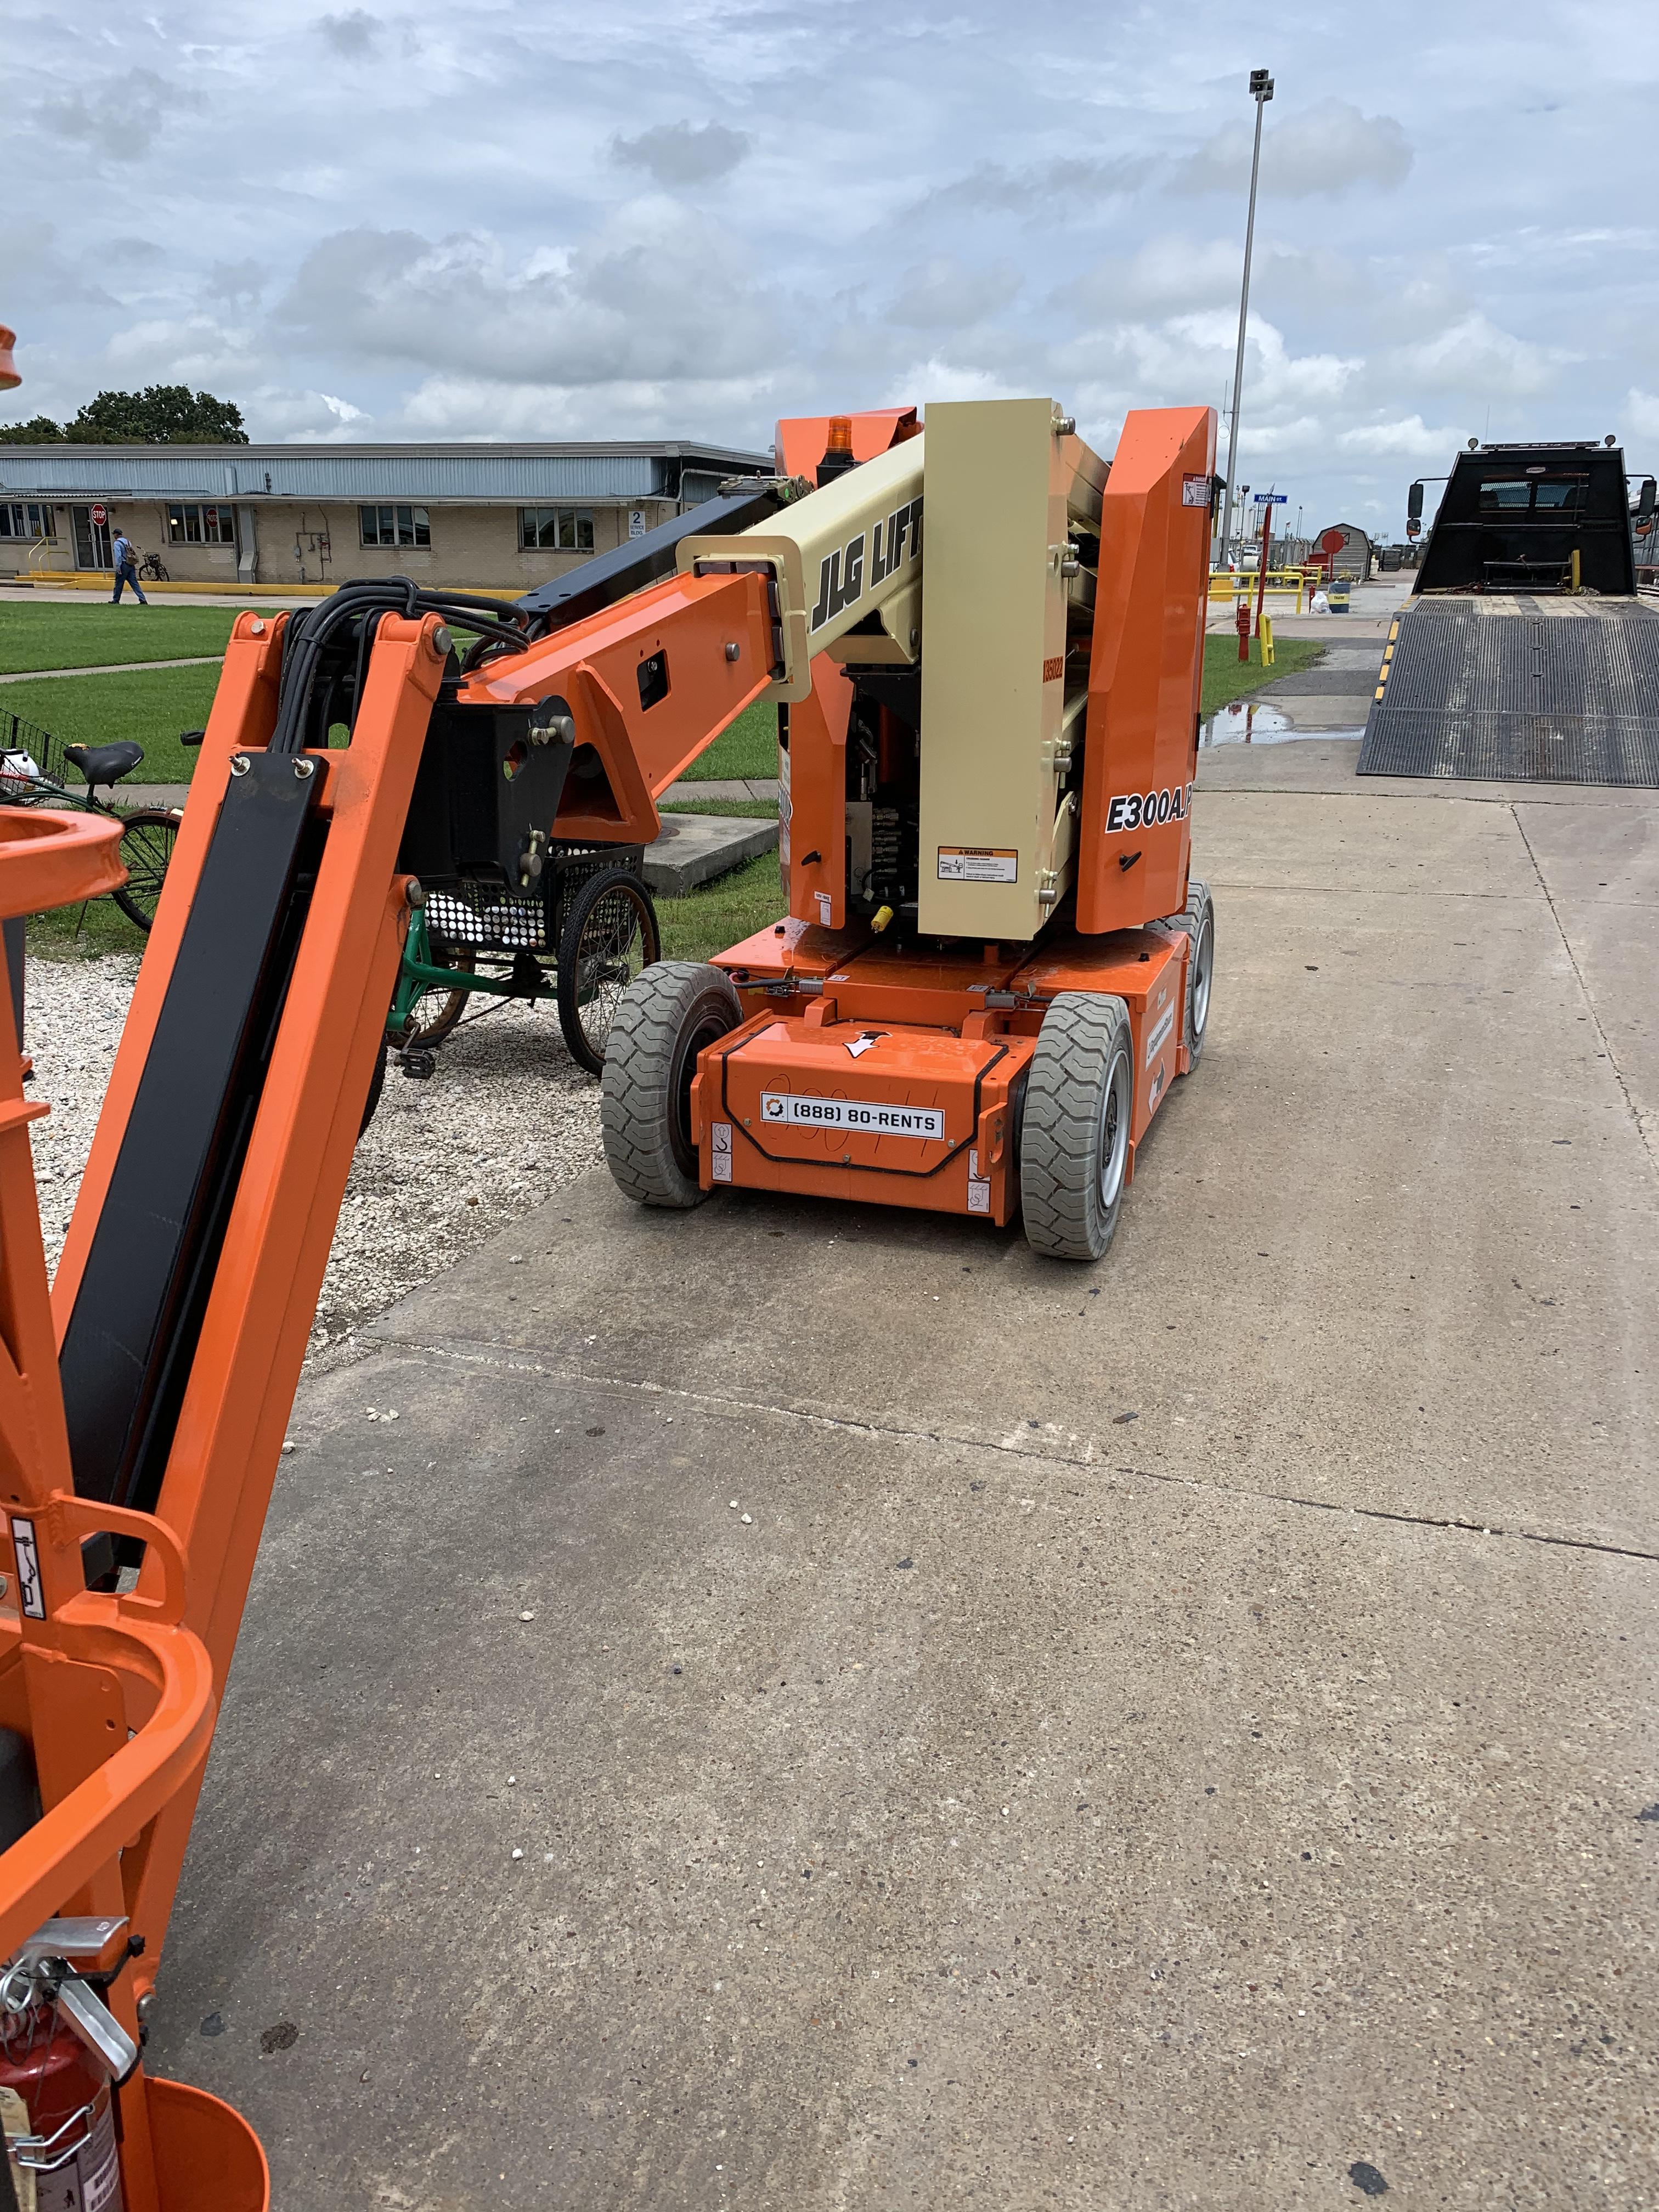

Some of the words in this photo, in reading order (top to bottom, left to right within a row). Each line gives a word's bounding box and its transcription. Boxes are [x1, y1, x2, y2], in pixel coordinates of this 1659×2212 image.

[93, 510, 105, 519] STOP
[633, 512, 641, 524] 2
[810, 531, 866, 636] JLG
[870, 493, 923, 591] LIFT
[1105, 782, 1193, 834] E300AJP
[794, 1103, 840, 1121] (888)
[848, 1109, 935, 1131] 80-RENTS
